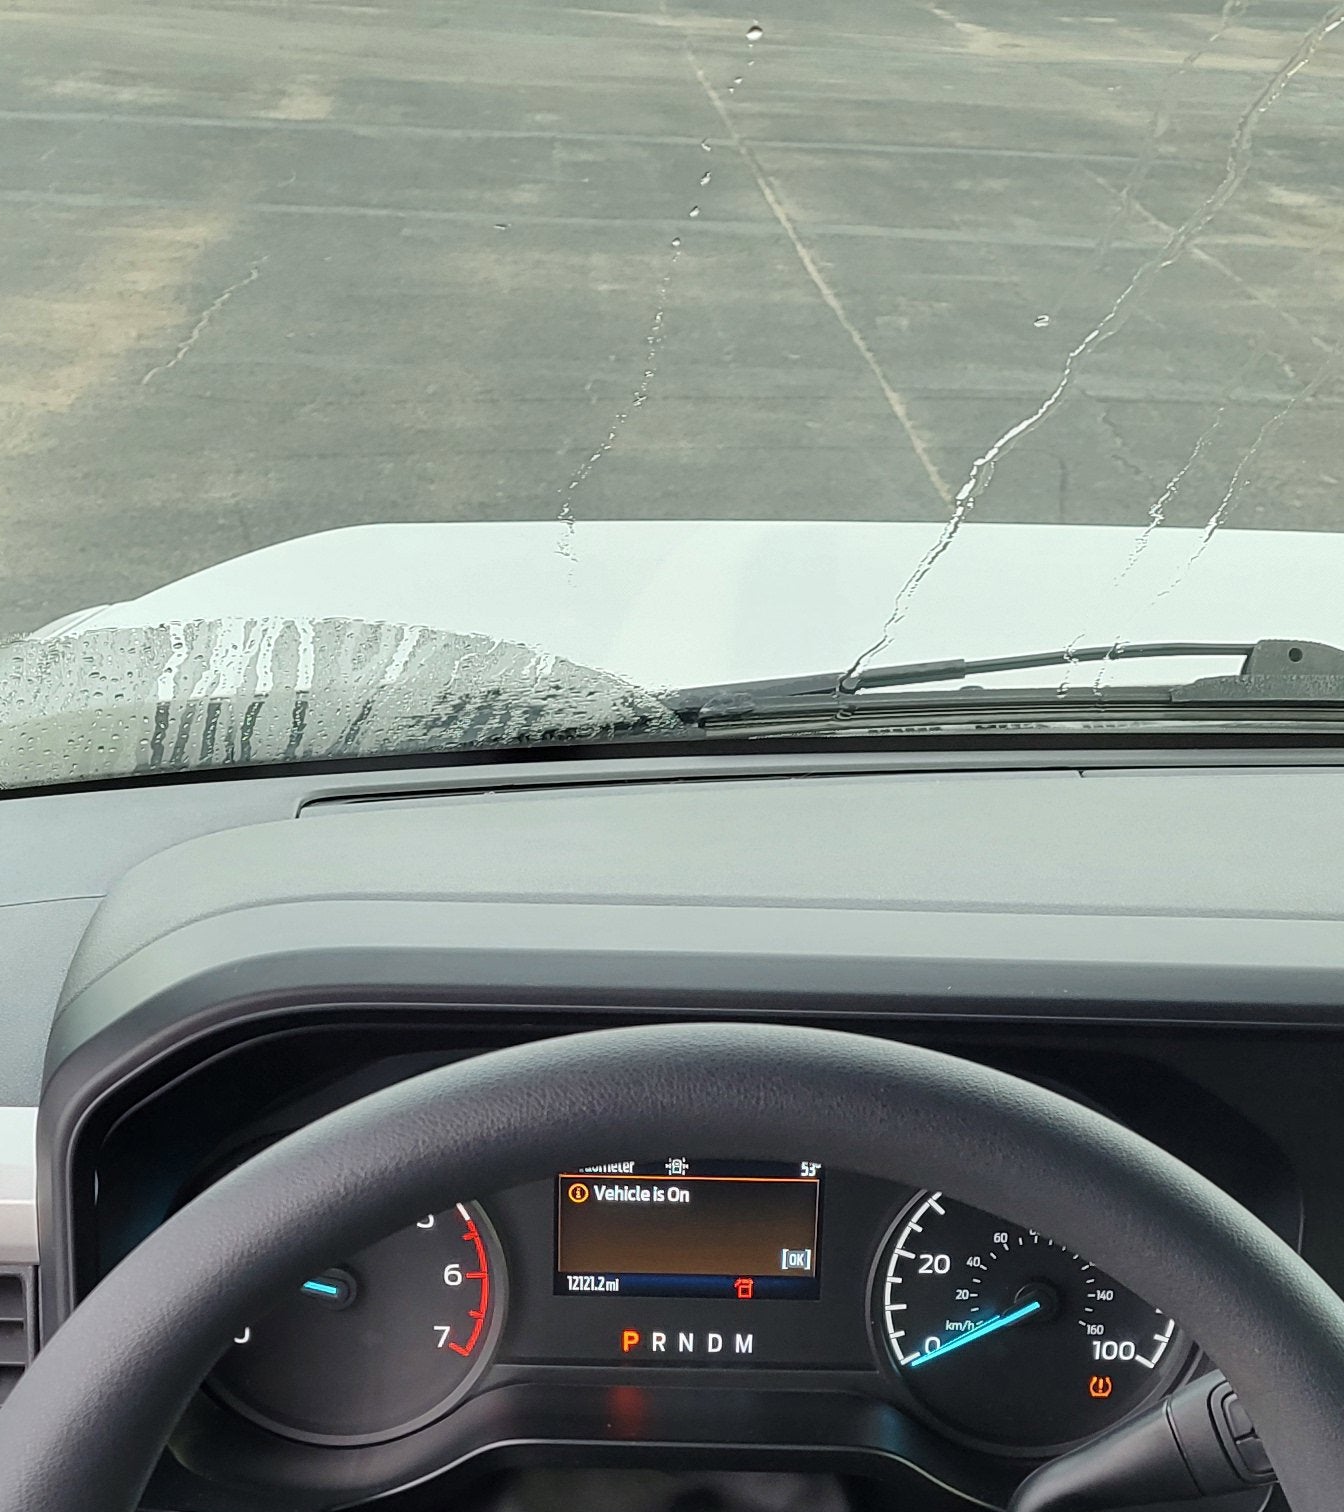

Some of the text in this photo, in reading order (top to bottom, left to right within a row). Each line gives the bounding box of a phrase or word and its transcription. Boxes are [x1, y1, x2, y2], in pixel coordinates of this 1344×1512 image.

[594, 1185, 690, 1203] Vehicle is On
[993, 1232, 1008, 1244] 60
[918, 1254, 951, 1274] 20
[966, 1256, 981, 1267] 40
[443, 1264, 463, 1286] 6
[955, 1289, 970, 1300] 20
[1096, 1289, 1114, 1301] 140
[945, 1320, 975, 1332] km/h
[1086, 1324, 1105, 1335] 160
[433, 1325, 451, 1348] 7
[623, 1330, 753, 1353] P R N D M
[925, 1336, 941, 1355] 0
[1092, 1341, 1136, 1360] 100
